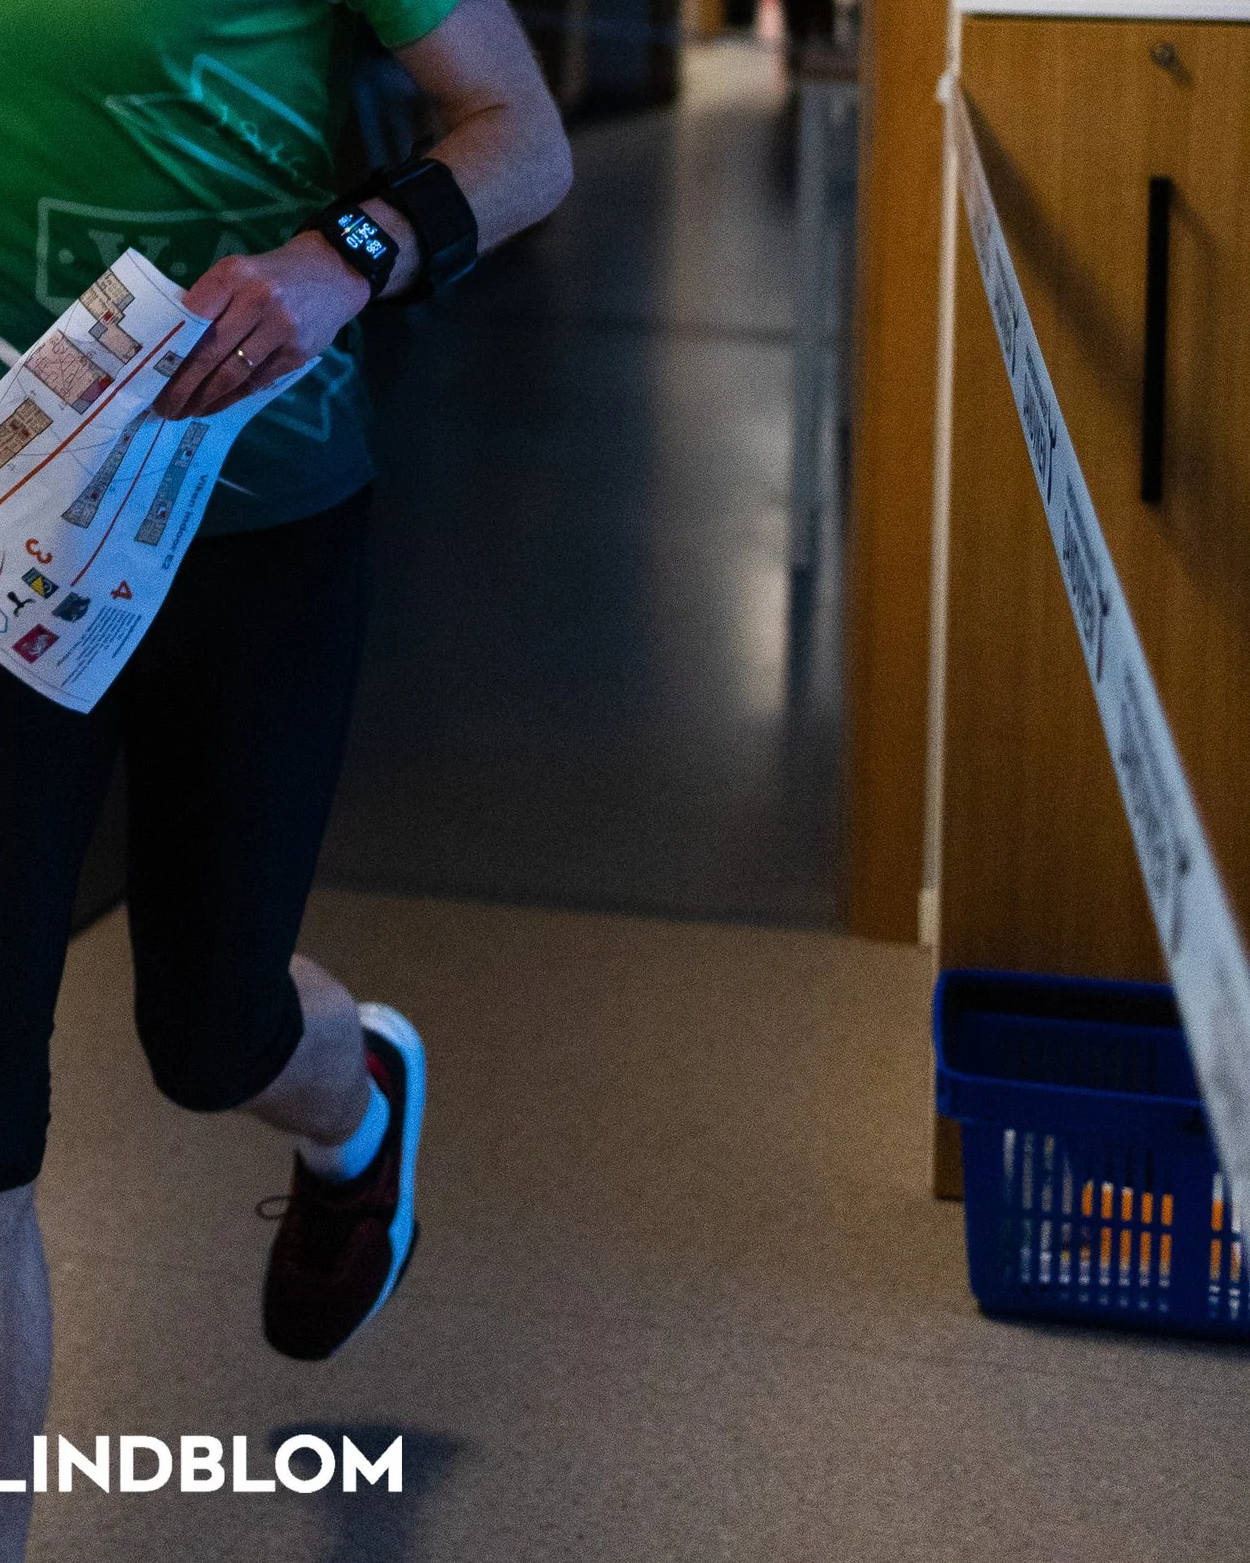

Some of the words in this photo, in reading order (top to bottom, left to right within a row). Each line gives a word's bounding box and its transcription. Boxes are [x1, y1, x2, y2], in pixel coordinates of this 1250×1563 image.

[172, 511, 192, 550] Indoor
[24, 537, 54, 565] 3
[110, 580, 133, 601] 4
